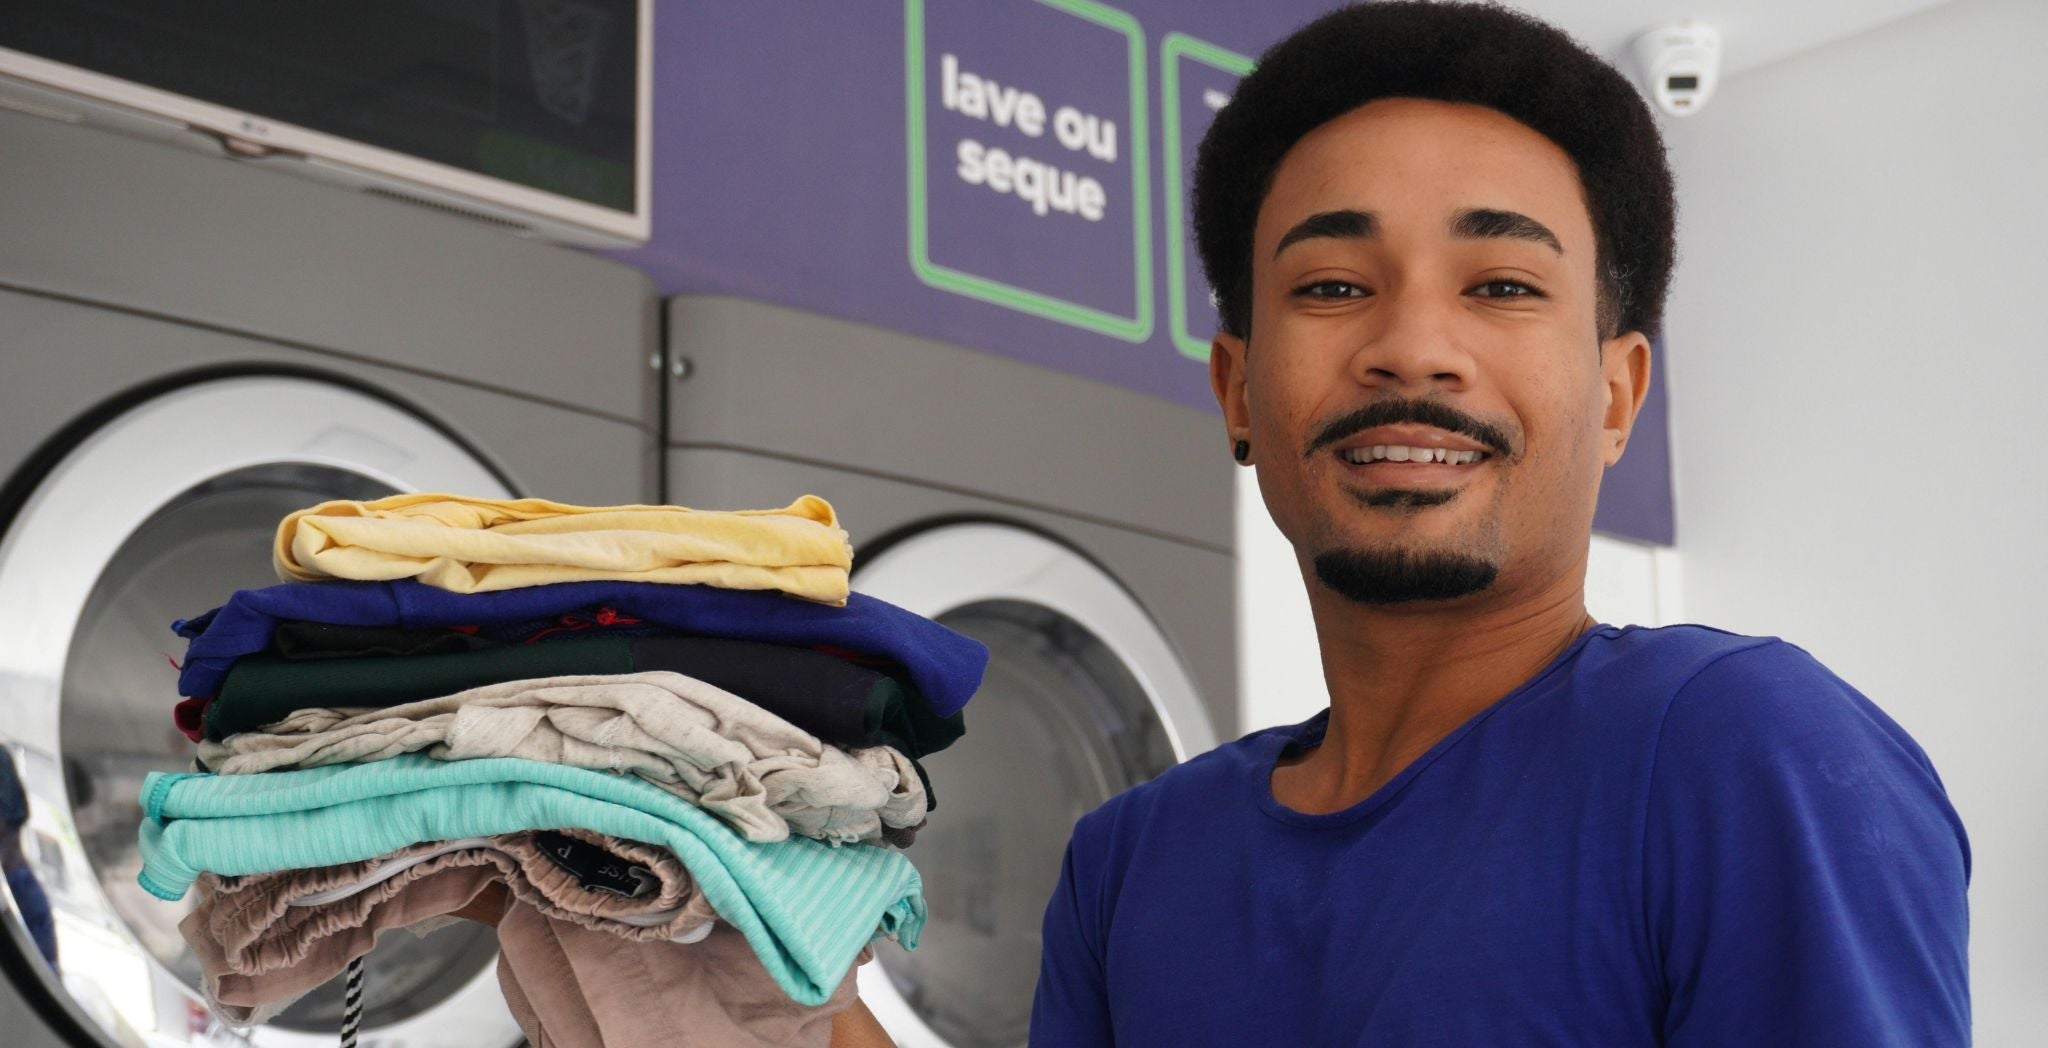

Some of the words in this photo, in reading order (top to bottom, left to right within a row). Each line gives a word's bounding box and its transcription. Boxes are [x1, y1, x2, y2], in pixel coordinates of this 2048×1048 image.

[942, 54, 1047, 137] lave
[1054, 106, 1117, 163] ou
[957, 139, 1107, 221] seque
